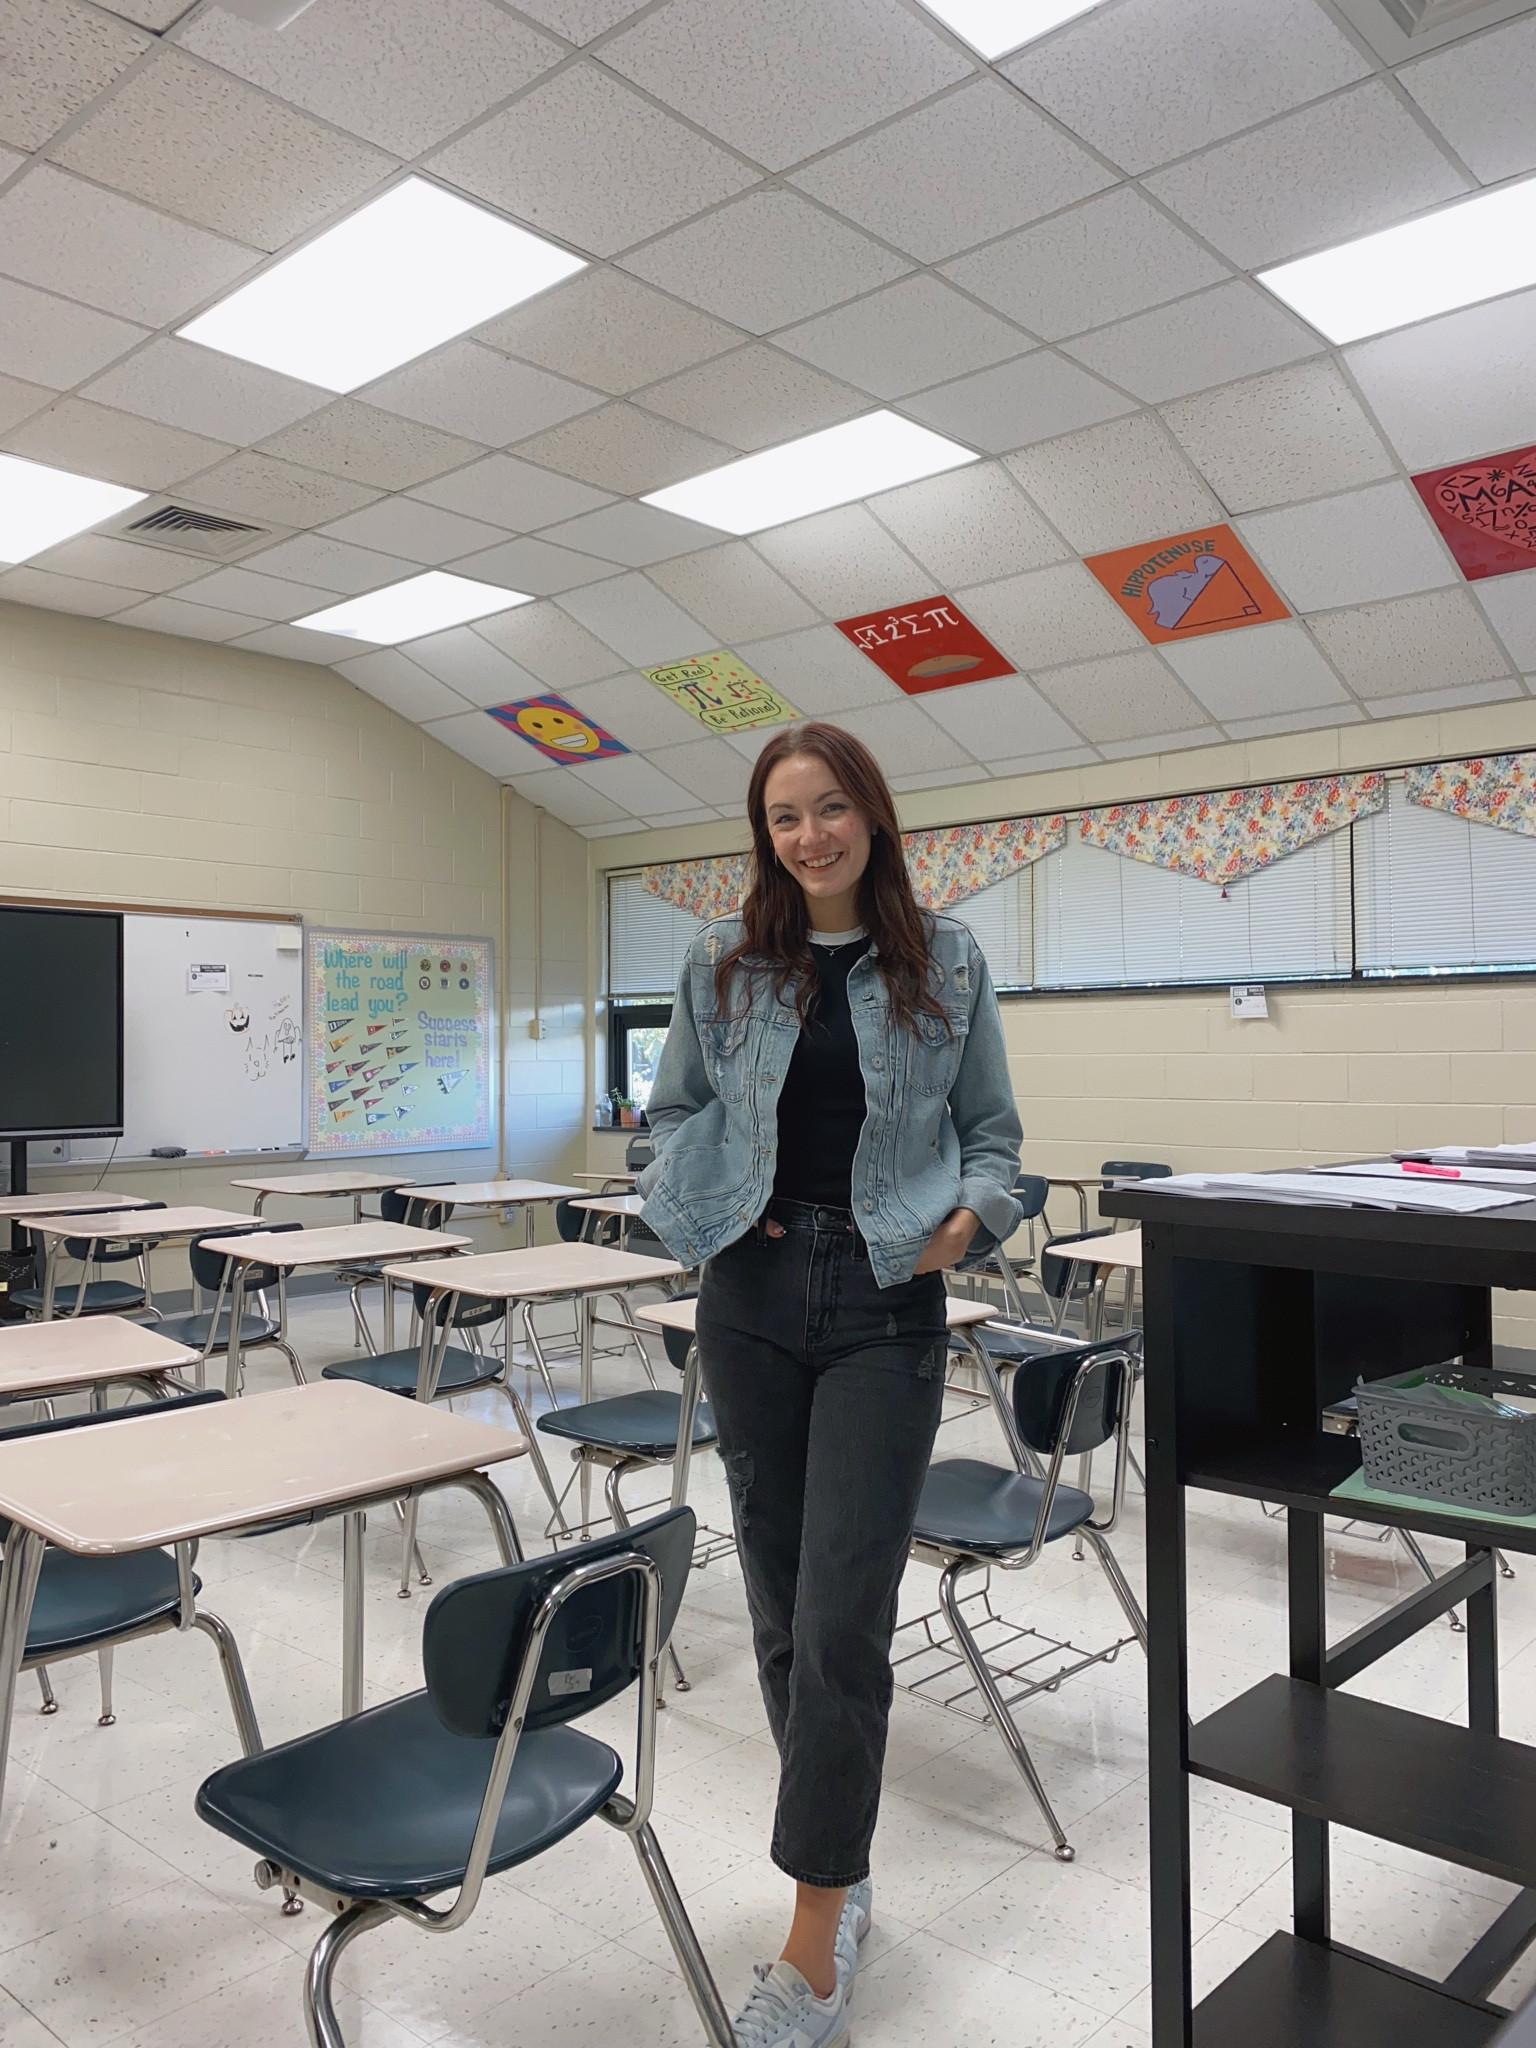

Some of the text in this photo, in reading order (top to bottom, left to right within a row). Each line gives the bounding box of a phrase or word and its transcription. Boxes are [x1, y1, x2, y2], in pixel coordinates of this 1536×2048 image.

[1120, 539, 1216, 598] HIPPOTENUSE
[655, 665, 706, 683] Get Real
[709, 700, 775, 725] Be Rational
[324, 948, 409, 970] Where will
[336, 970, 404, 991] the road
[326, 991, 409, 1019] lead you?
[418, 1010, 478, 1033] Success
[424, 1031, 467, 1048] starts
[425, 1049, 460, 1068] here!
